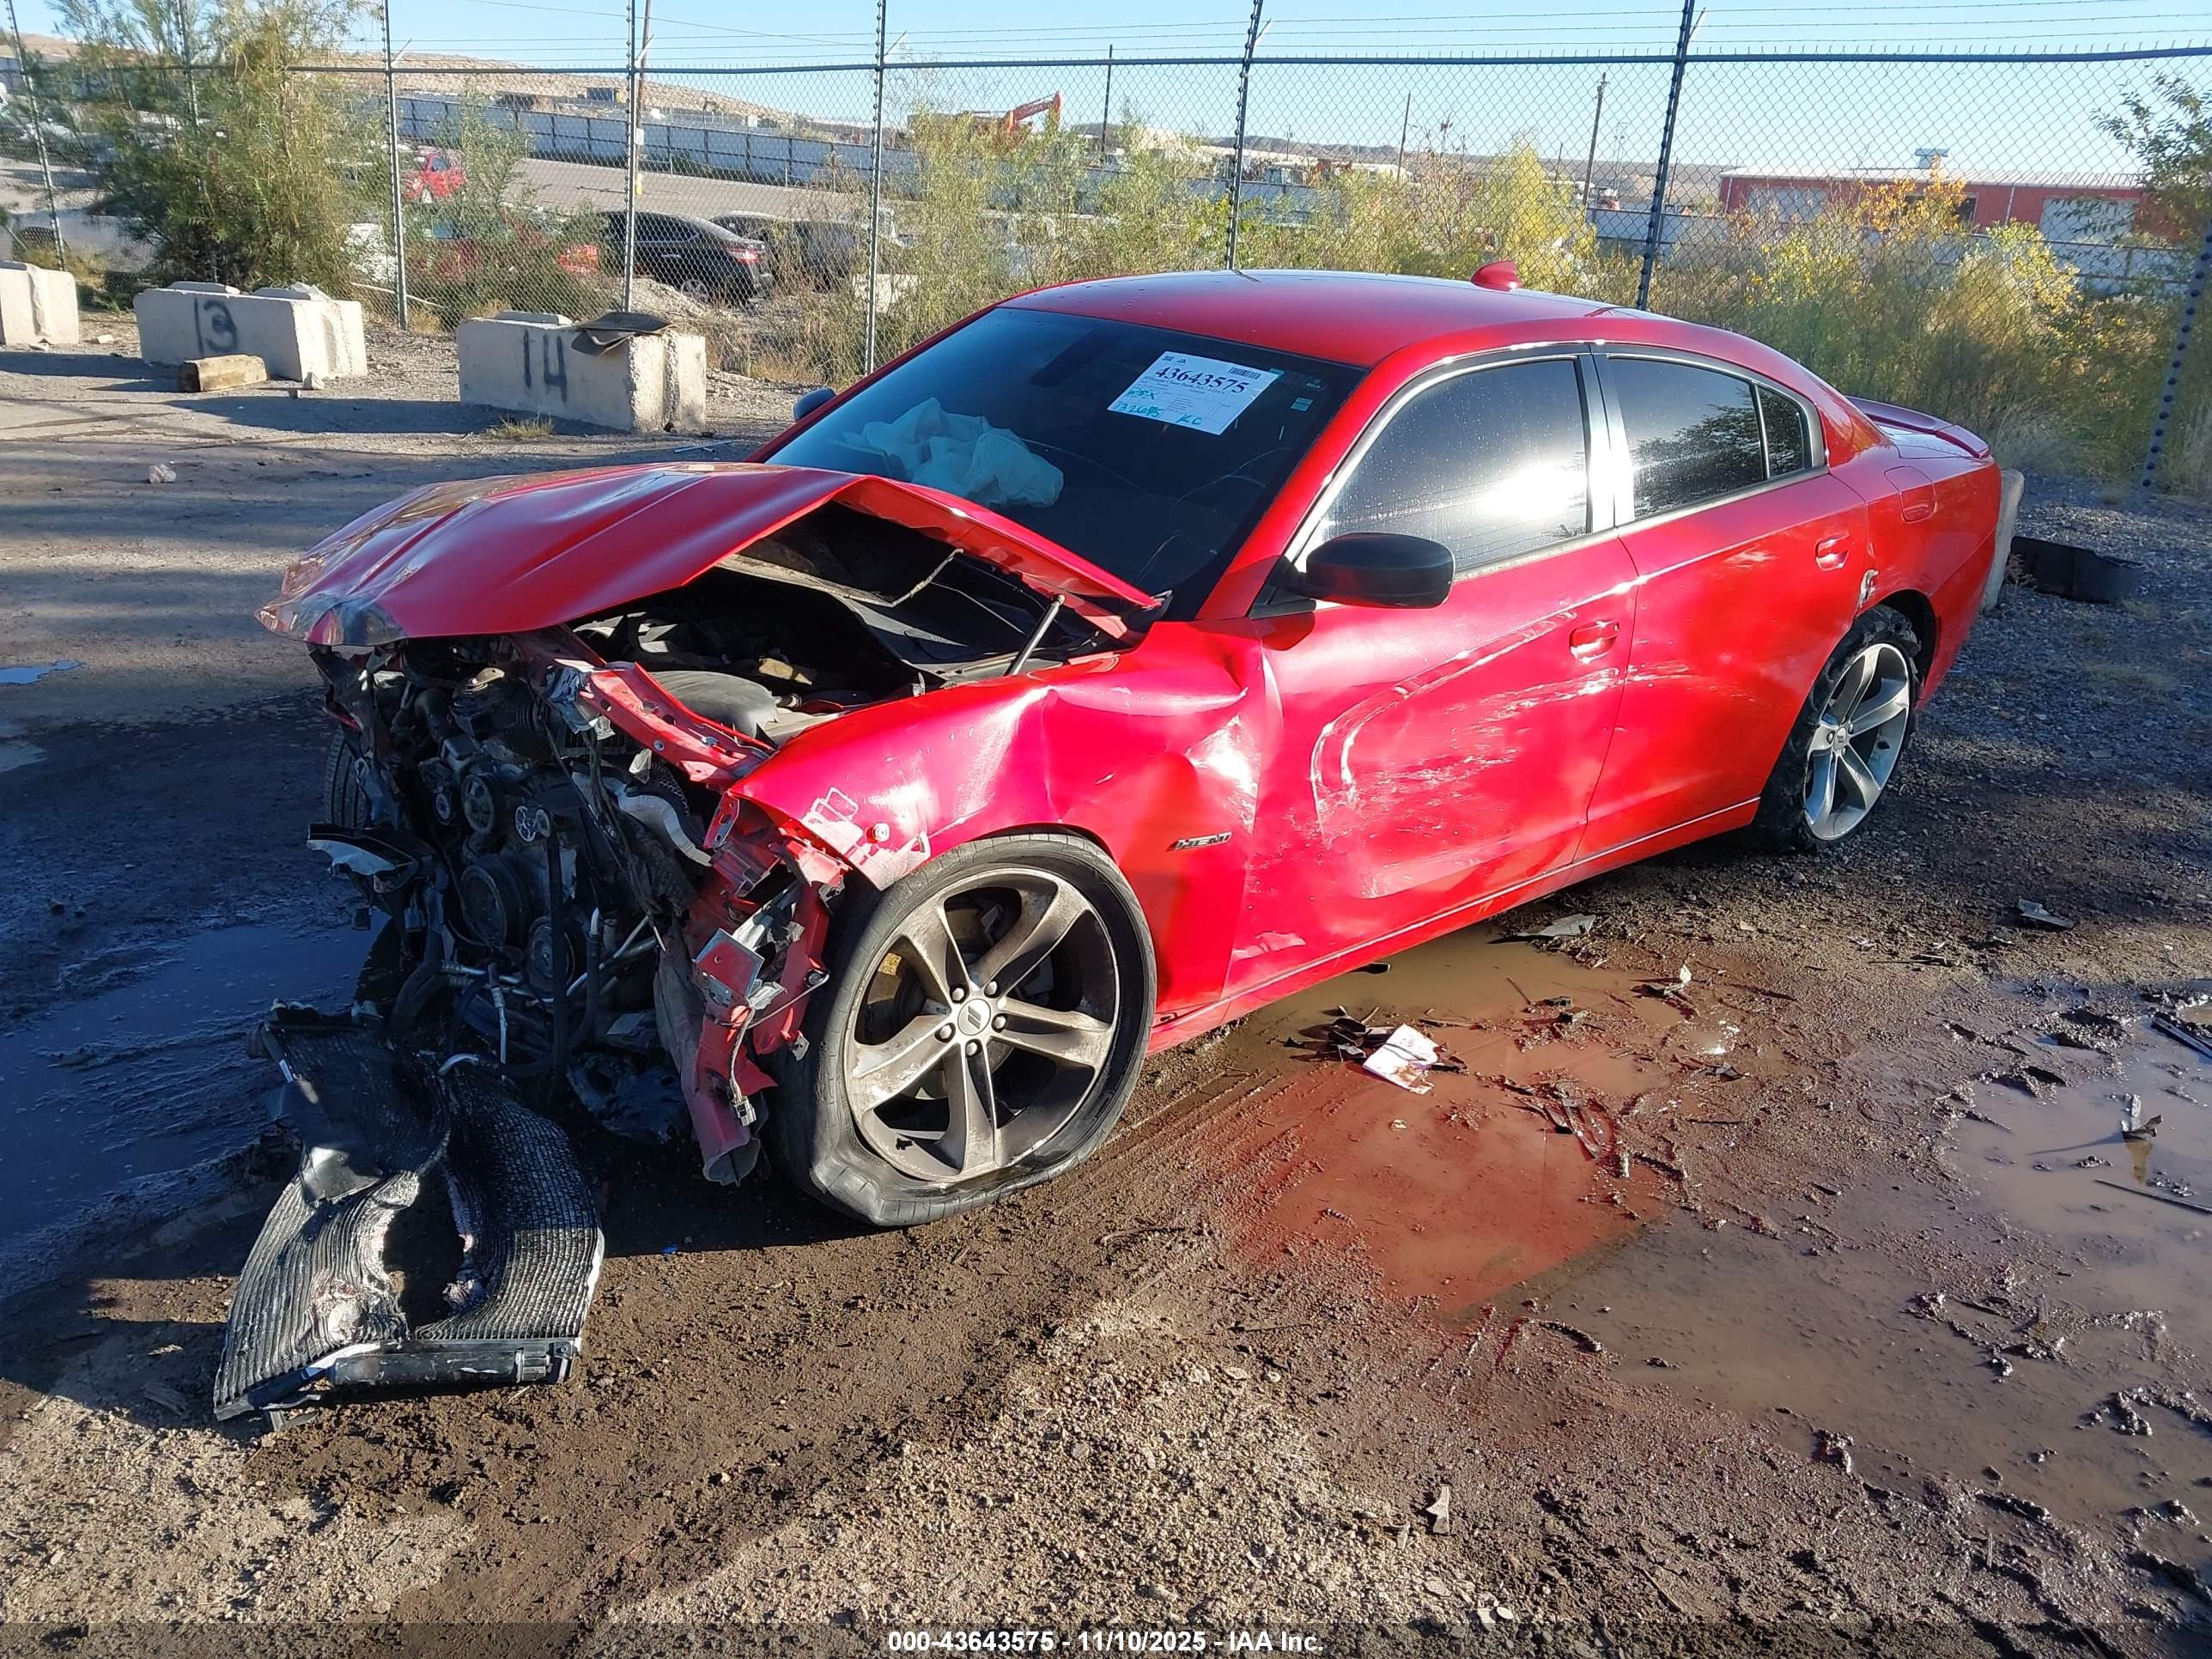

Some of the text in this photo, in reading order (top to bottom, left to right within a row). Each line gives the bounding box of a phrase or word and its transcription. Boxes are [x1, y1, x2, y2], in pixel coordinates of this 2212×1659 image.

[193, 297, 239, 355] 13
[523, 329, 568, 404] 14
[1156, 367, 1250, 393] 43643575
